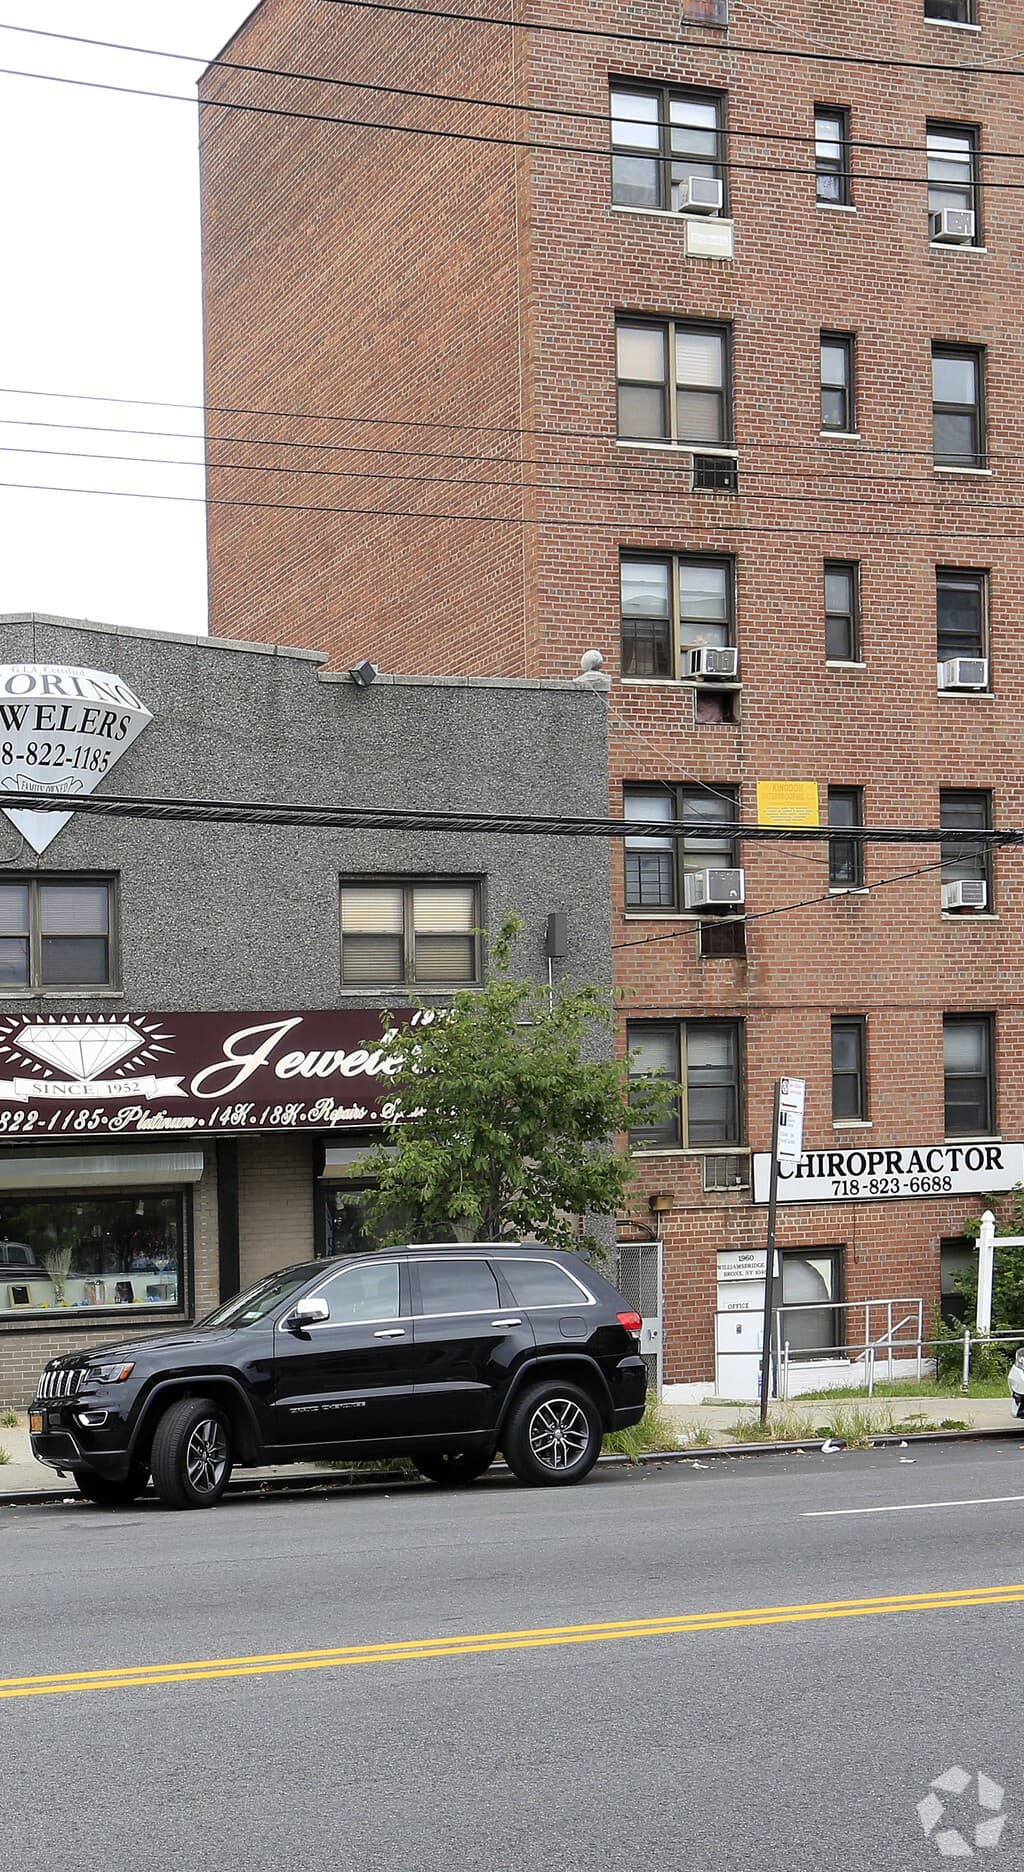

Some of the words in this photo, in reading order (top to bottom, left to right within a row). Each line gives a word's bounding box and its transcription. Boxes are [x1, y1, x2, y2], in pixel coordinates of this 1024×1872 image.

[32, 1083, 95, 1096] SINCE
[107, 1082, 141, 1094] 1952
[108, 1105, 198, 1131] Platinum
[208, 1103, 256, 1127] 14K
[260, 1102, 305, 1126] 18K
[777, 1147, 1004, 1179] CHIROPRACTOR
[831, 1176, 953, 1196] 718-823-6688
